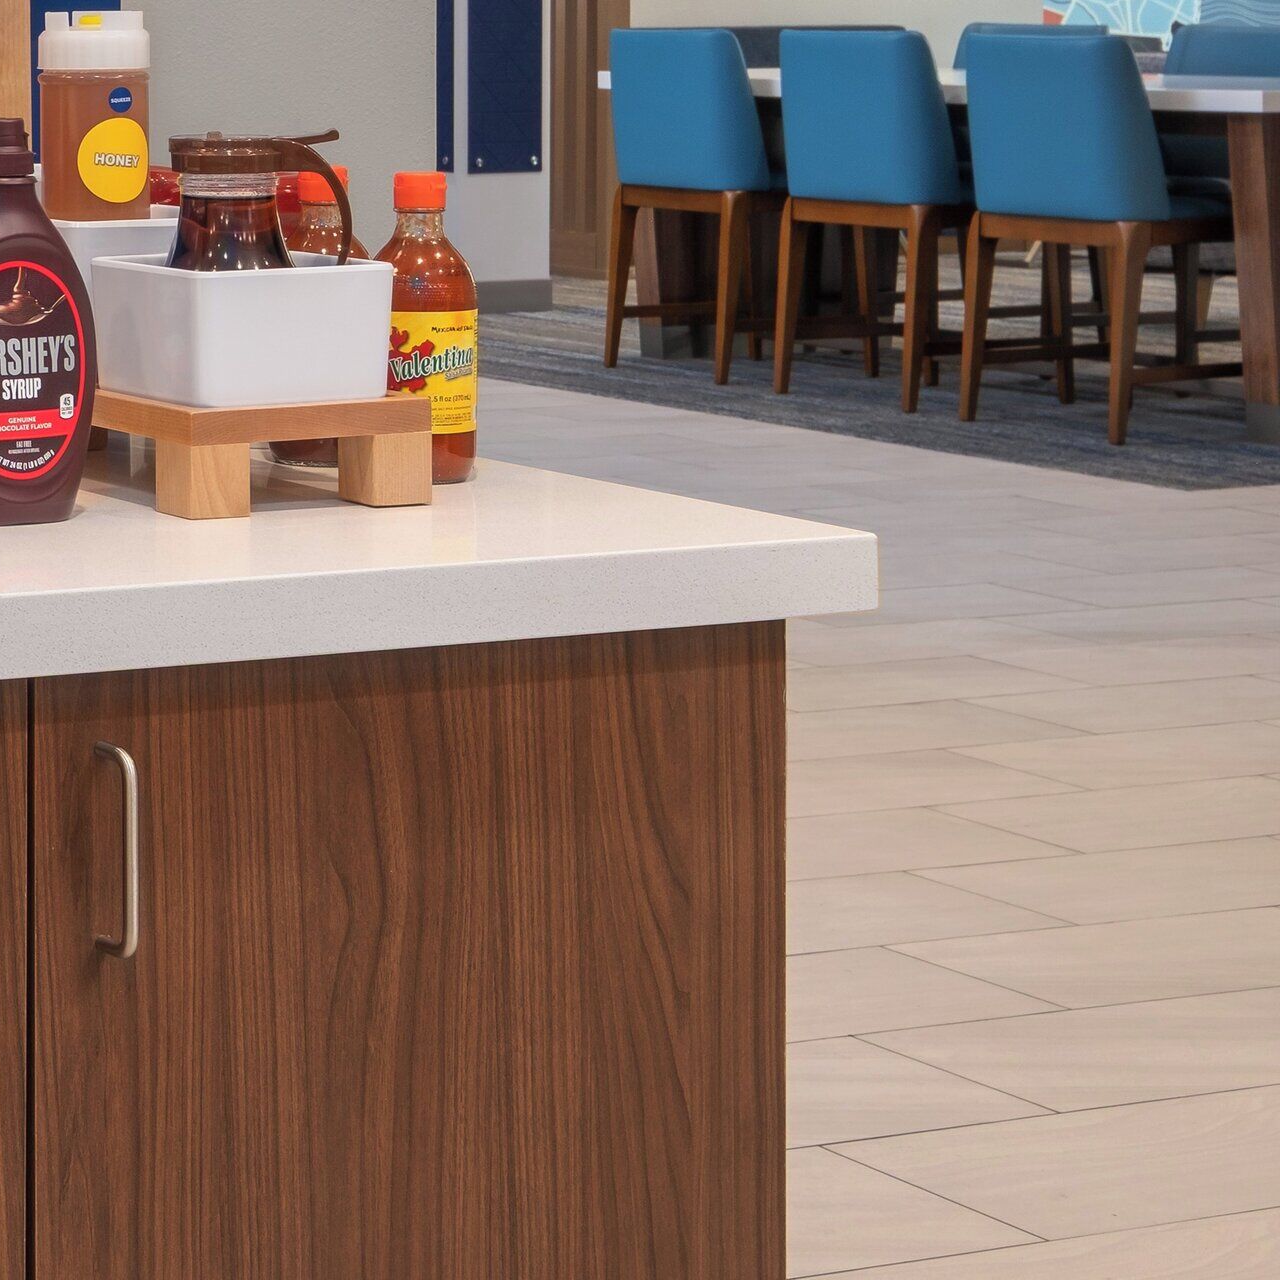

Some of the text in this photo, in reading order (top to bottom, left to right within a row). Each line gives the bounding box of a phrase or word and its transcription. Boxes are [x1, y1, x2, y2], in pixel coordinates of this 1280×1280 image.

[94, 152, 140, 168] HONEY
[389, 346, 473, 382] Valentina
[1, 377, 42, 401] SYRUP
[63, 396, 71, 406] 45
[8, 416, 36, 424] GENUINE
[30, 422, 52, 430] FLAVOR
